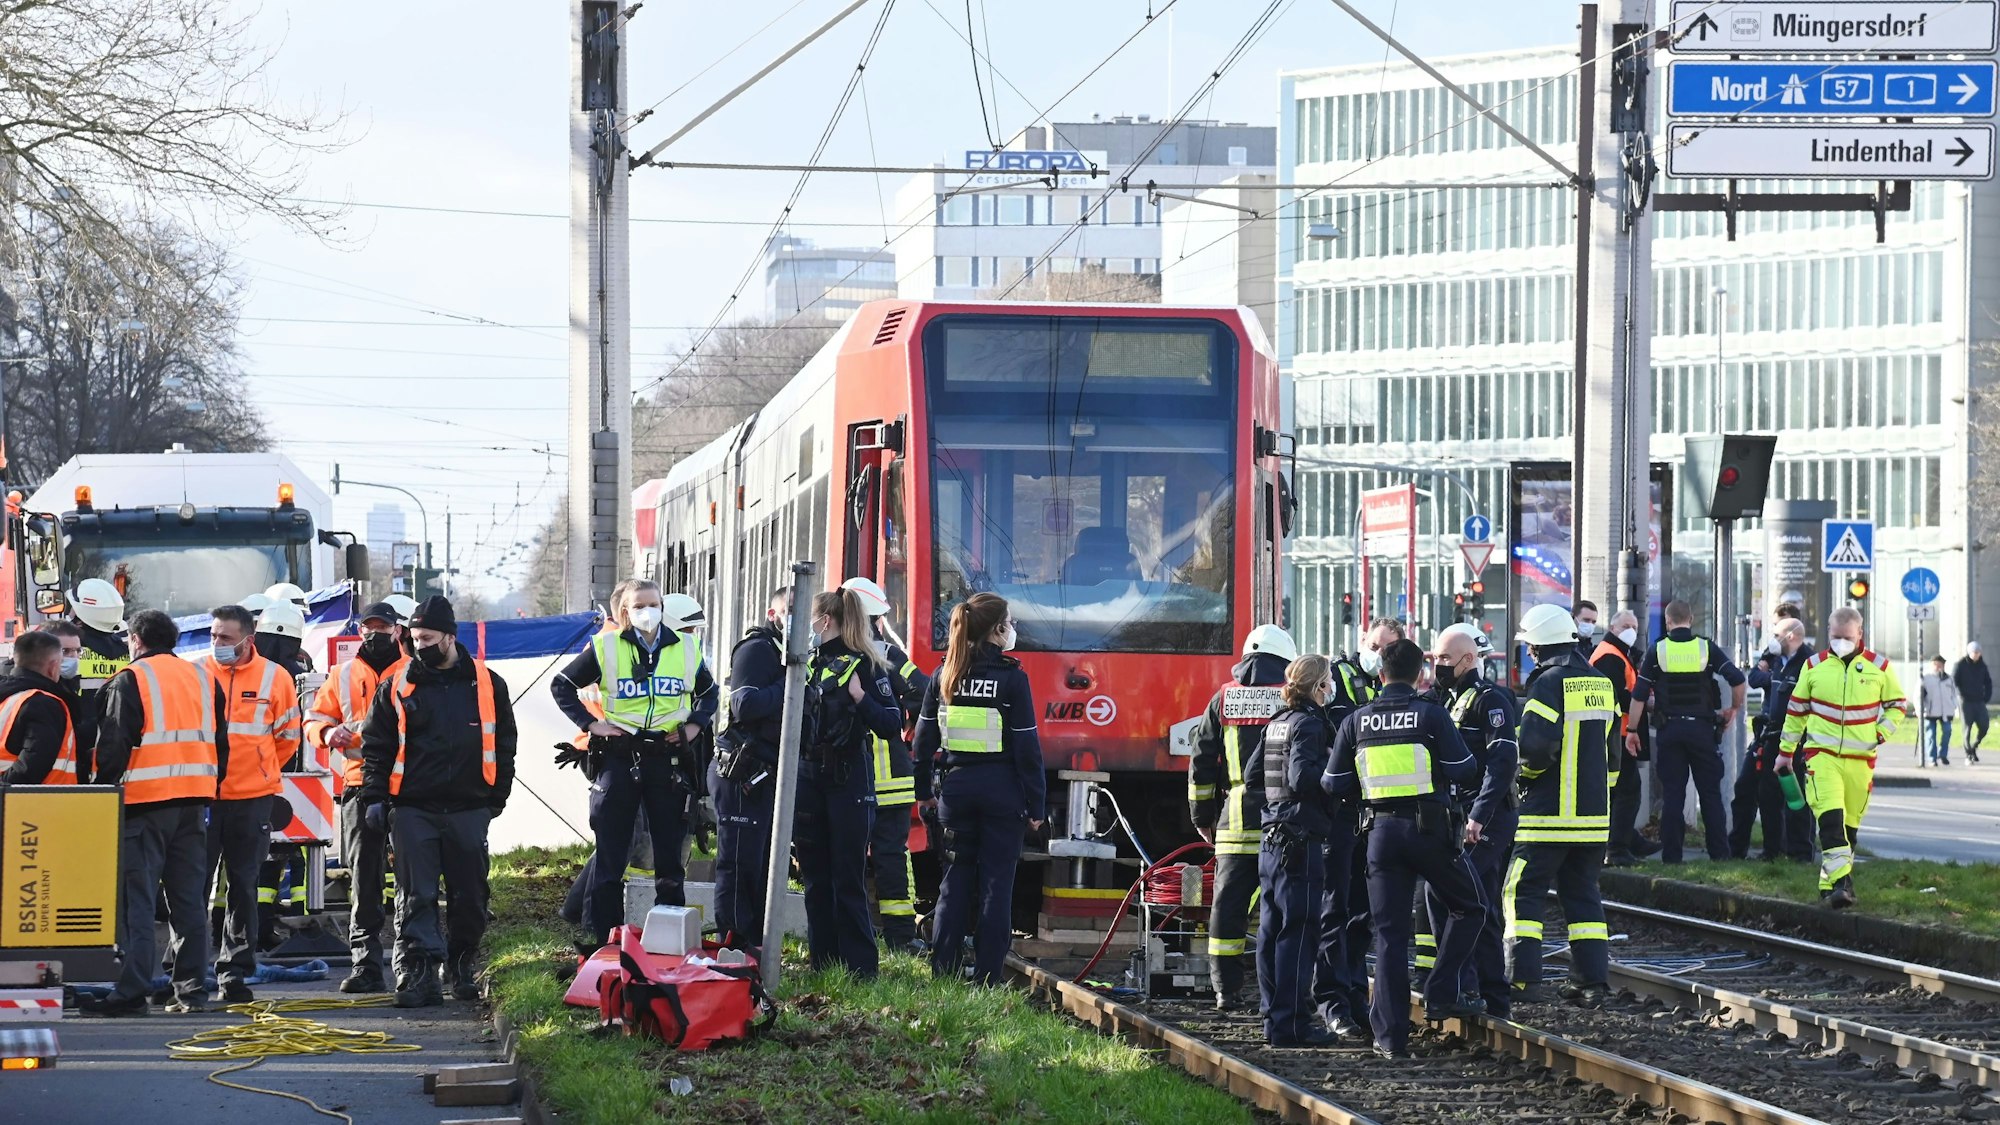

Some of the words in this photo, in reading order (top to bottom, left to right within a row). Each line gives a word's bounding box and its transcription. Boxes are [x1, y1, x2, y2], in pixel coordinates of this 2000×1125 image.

[1773, 13, 1927, 42] Müngersdorf
[1711, 76, 1767, 101] Nord
[1834, 79, 1859, 99] 57
[1907, 80, 1914, 99] 1
[966, 151, 1086, 171] EUROPA
[1811, 138, 1932, 163] Lindenthal
[92, 662, 117, 674] KÖLN
[953, 679, 998, 698] LIZEI
[1226, 688, 1282, 700] RÜSTZUGFÜHR
[1584, 692, 1605, 707] KÖLN
[1045, 702, 1085, 719] KVB
[1360, 711, 1418, 732] POLIZEI
[20, 821, 39, 871] 14EV
[41, 869, 51, 900] SILENT
[19, 880, 37, 932] BSKA
[40, 903, 50, 933] SUPER
